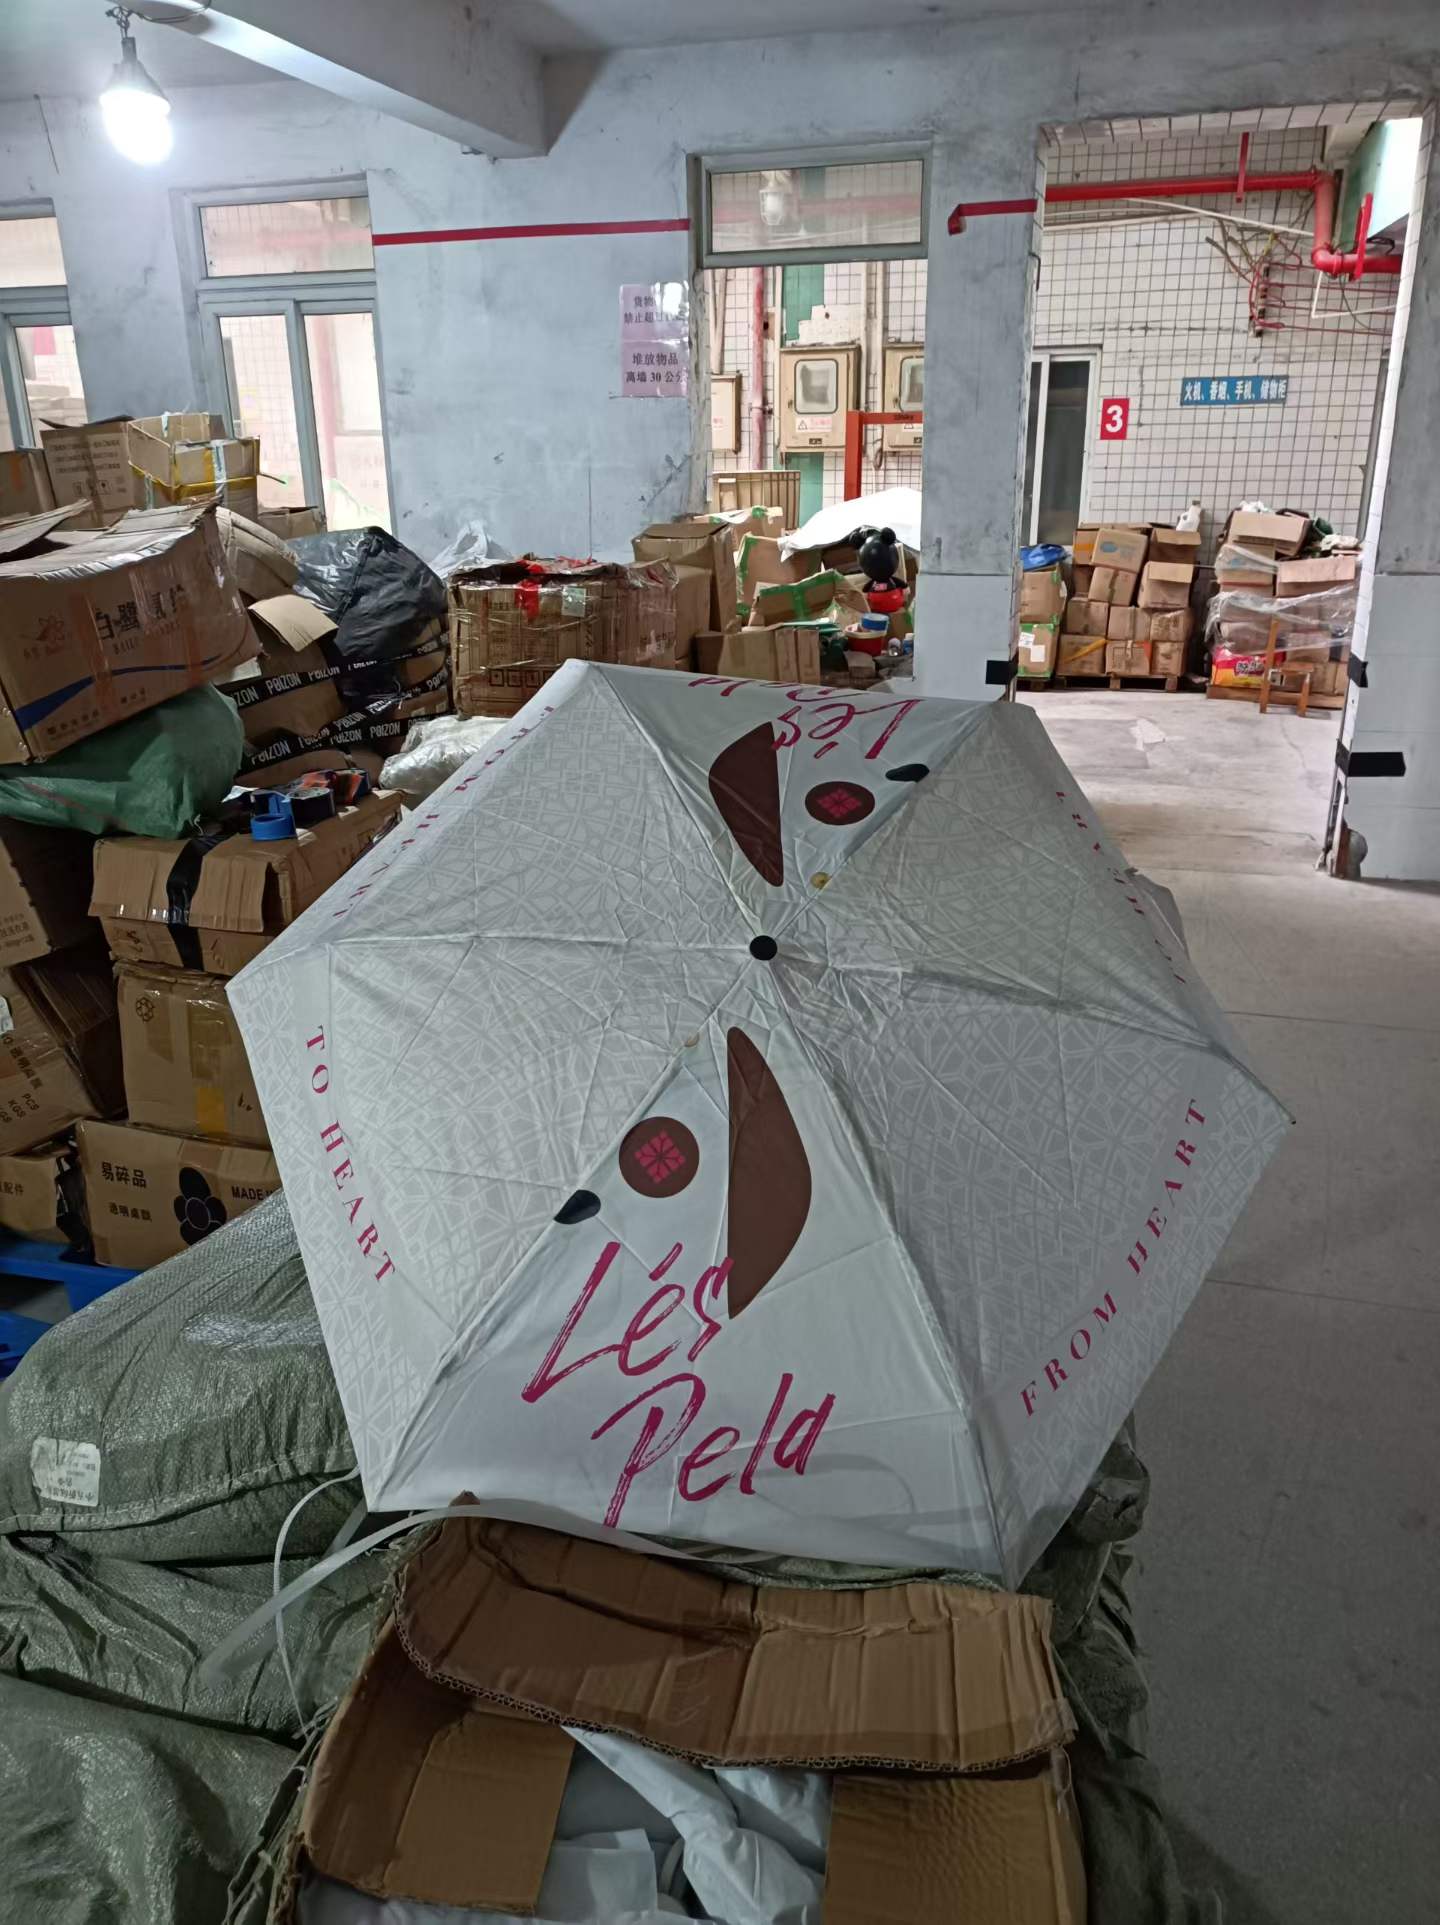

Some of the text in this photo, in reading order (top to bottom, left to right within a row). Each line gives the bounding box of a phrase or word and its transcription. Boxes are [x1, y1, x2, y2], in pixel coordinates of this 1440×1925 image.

[632, 352, 679, 365] 堆放物品
[650, 372, 662, 383] 30
[1104, 403, 1124, 434] 3
[306, 1024, 396, 1281] TO HEART
[101, 1161, 147, 1189] 易碎品
[231, 1185, 265, 1201] MADE
[1020, 1098, 1206, 1417] FROM HEART
[591, 1372, 836, 1528] Pela
